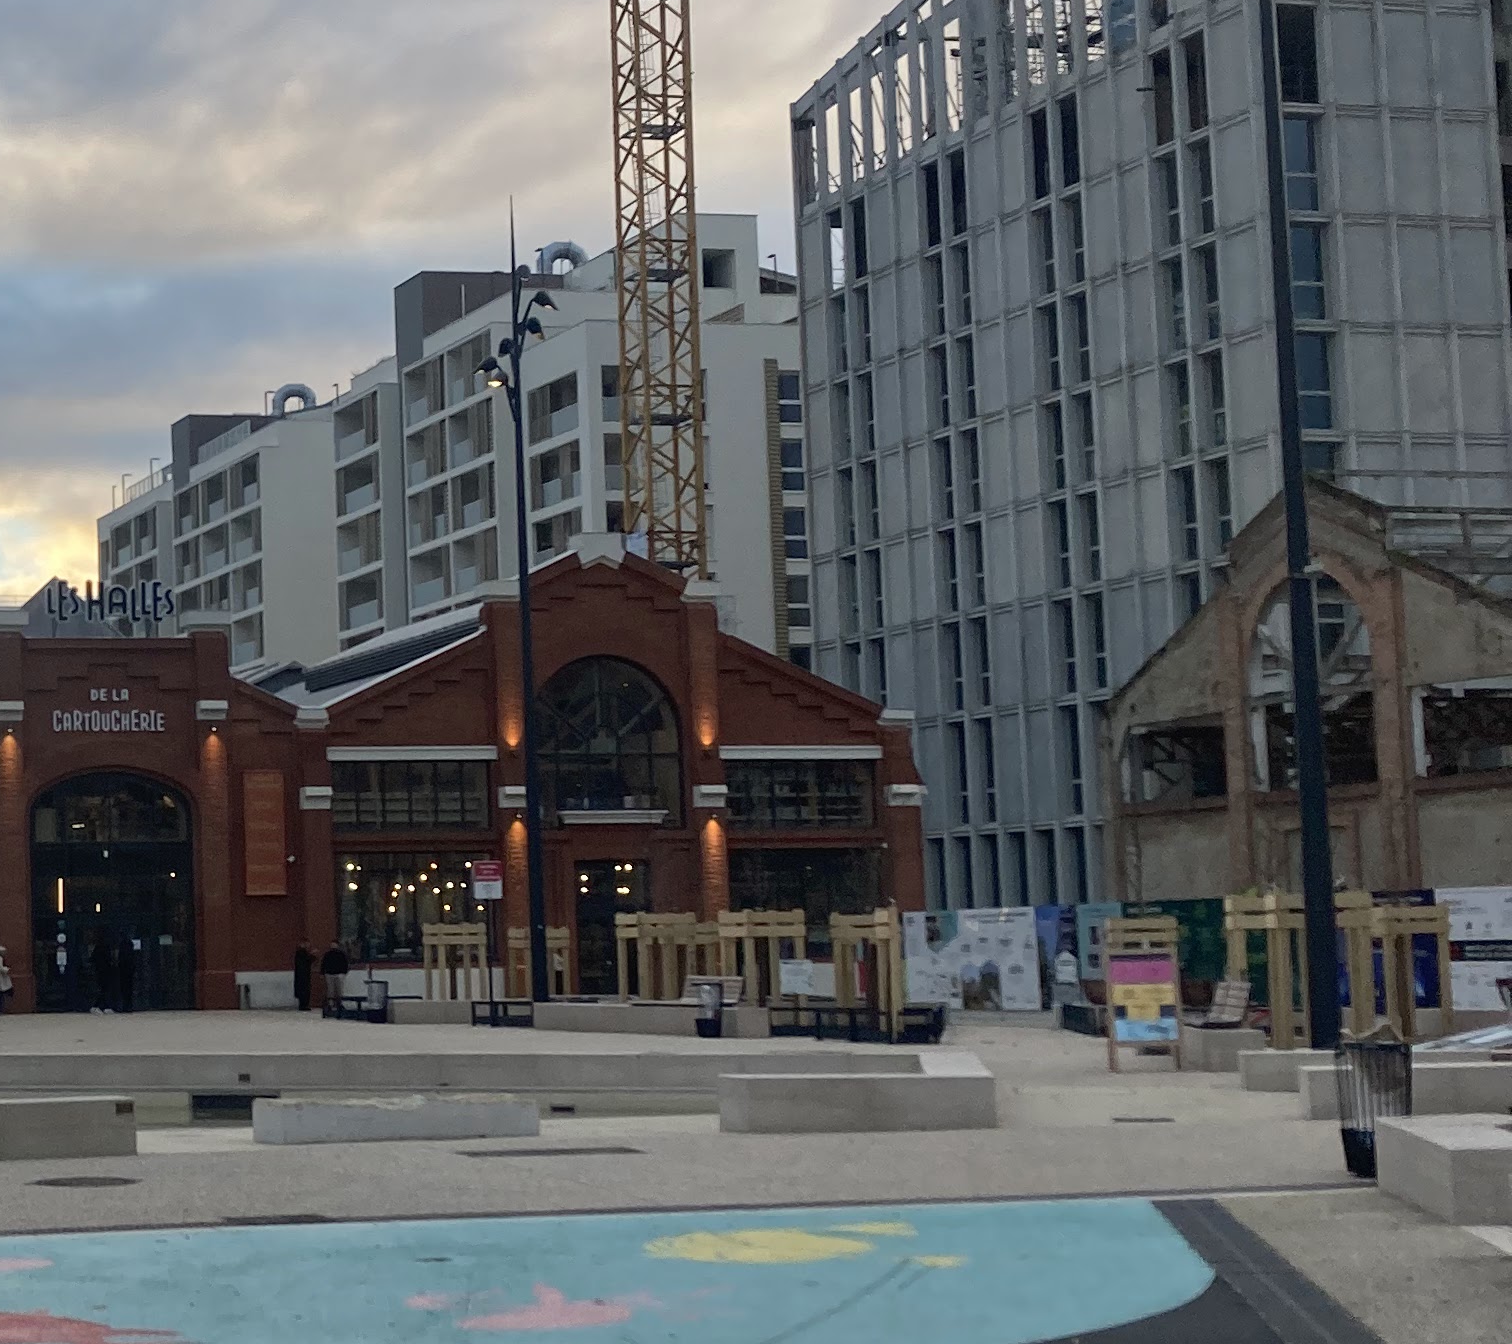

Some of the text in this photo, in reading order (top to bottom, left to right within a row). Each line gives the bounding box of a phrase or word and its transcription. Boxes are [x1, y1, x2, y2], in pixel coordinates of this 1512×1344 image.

[46, 580, 175, 622] LES HALLES
[90, 688, 129, 702] DE LA
[52, 709, 166, 732] CARTOUCHERIE
